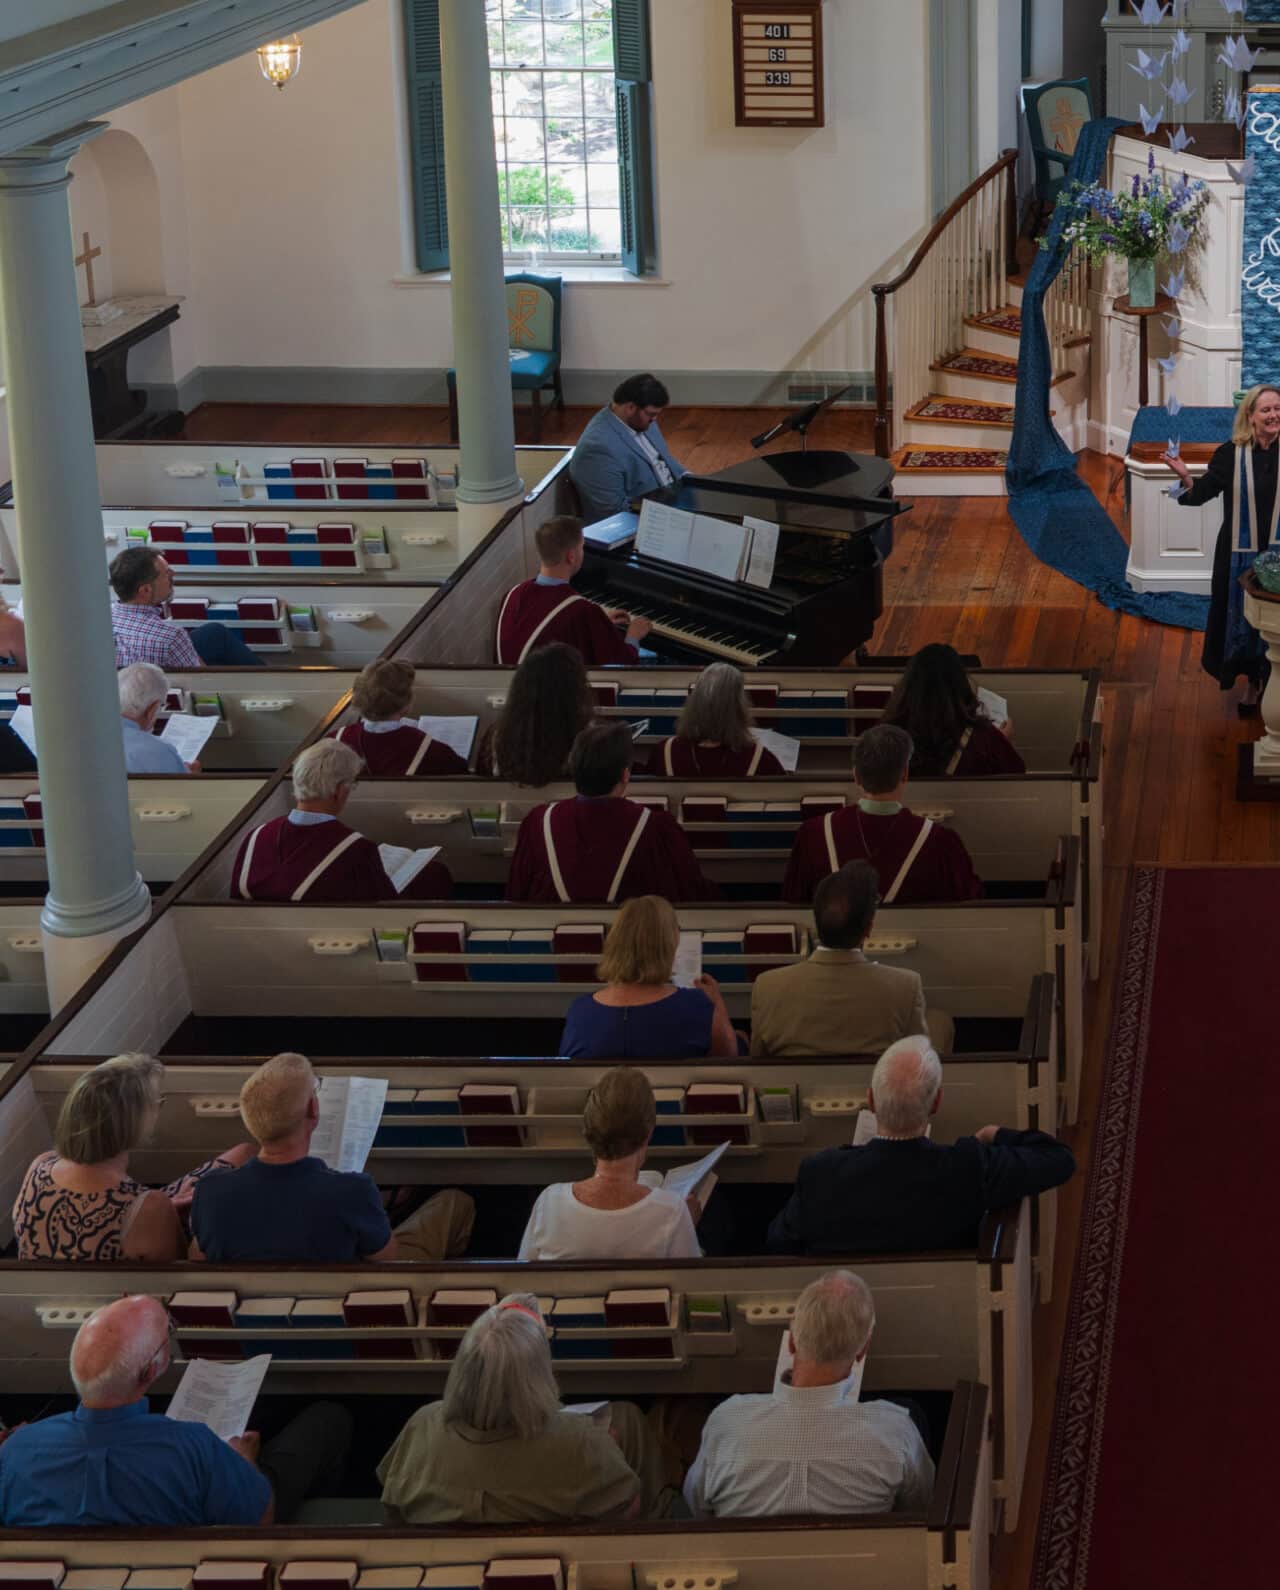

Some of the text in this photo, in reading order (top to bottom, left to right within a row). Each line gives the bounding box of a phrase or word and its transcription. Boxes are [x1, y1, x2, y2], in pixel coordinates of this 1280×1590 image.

[765, 24, 788, 38] 401
[769, 48, 785, 61] 69
[766, 72, 790, 85] 339
